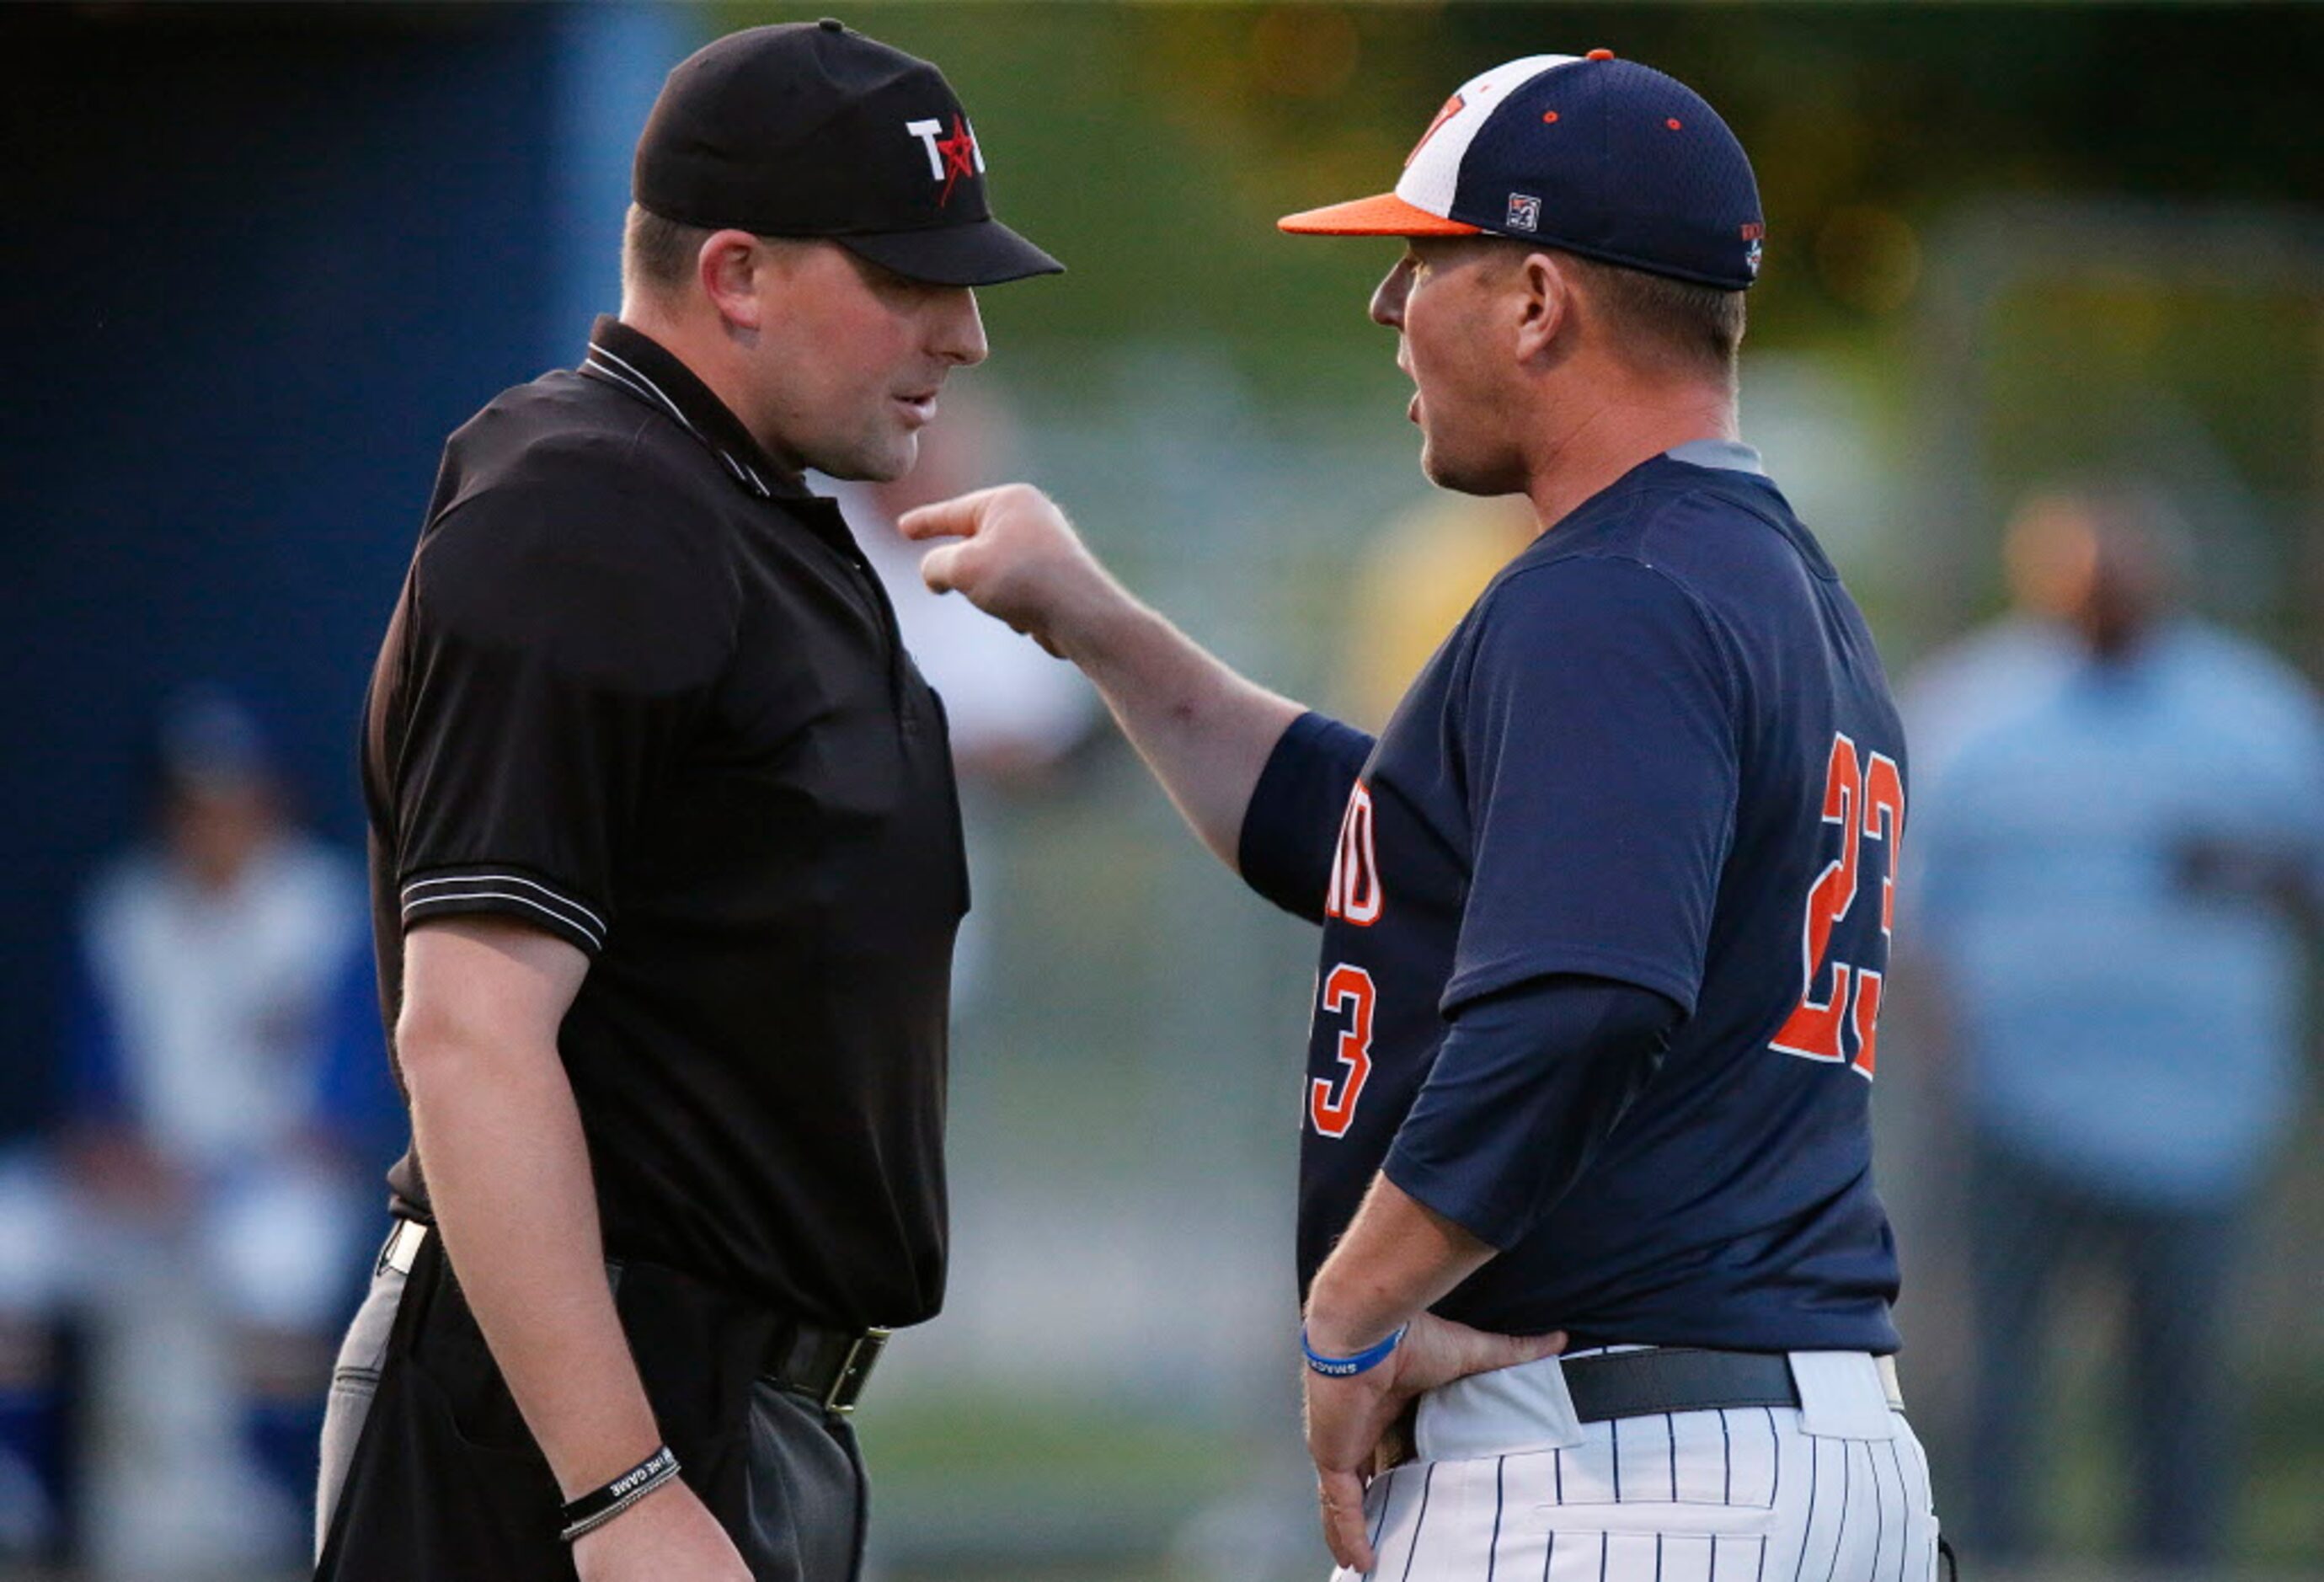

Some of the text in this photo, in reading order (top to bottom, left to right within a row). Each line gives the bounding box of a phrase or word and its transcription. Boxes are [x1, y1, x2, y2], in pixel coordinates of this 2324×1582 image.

[1767, 730, 1905, 1082] 23
[1301, 961, 1376, 1140] 3
[609, 1468, 648, 1497] GAME
